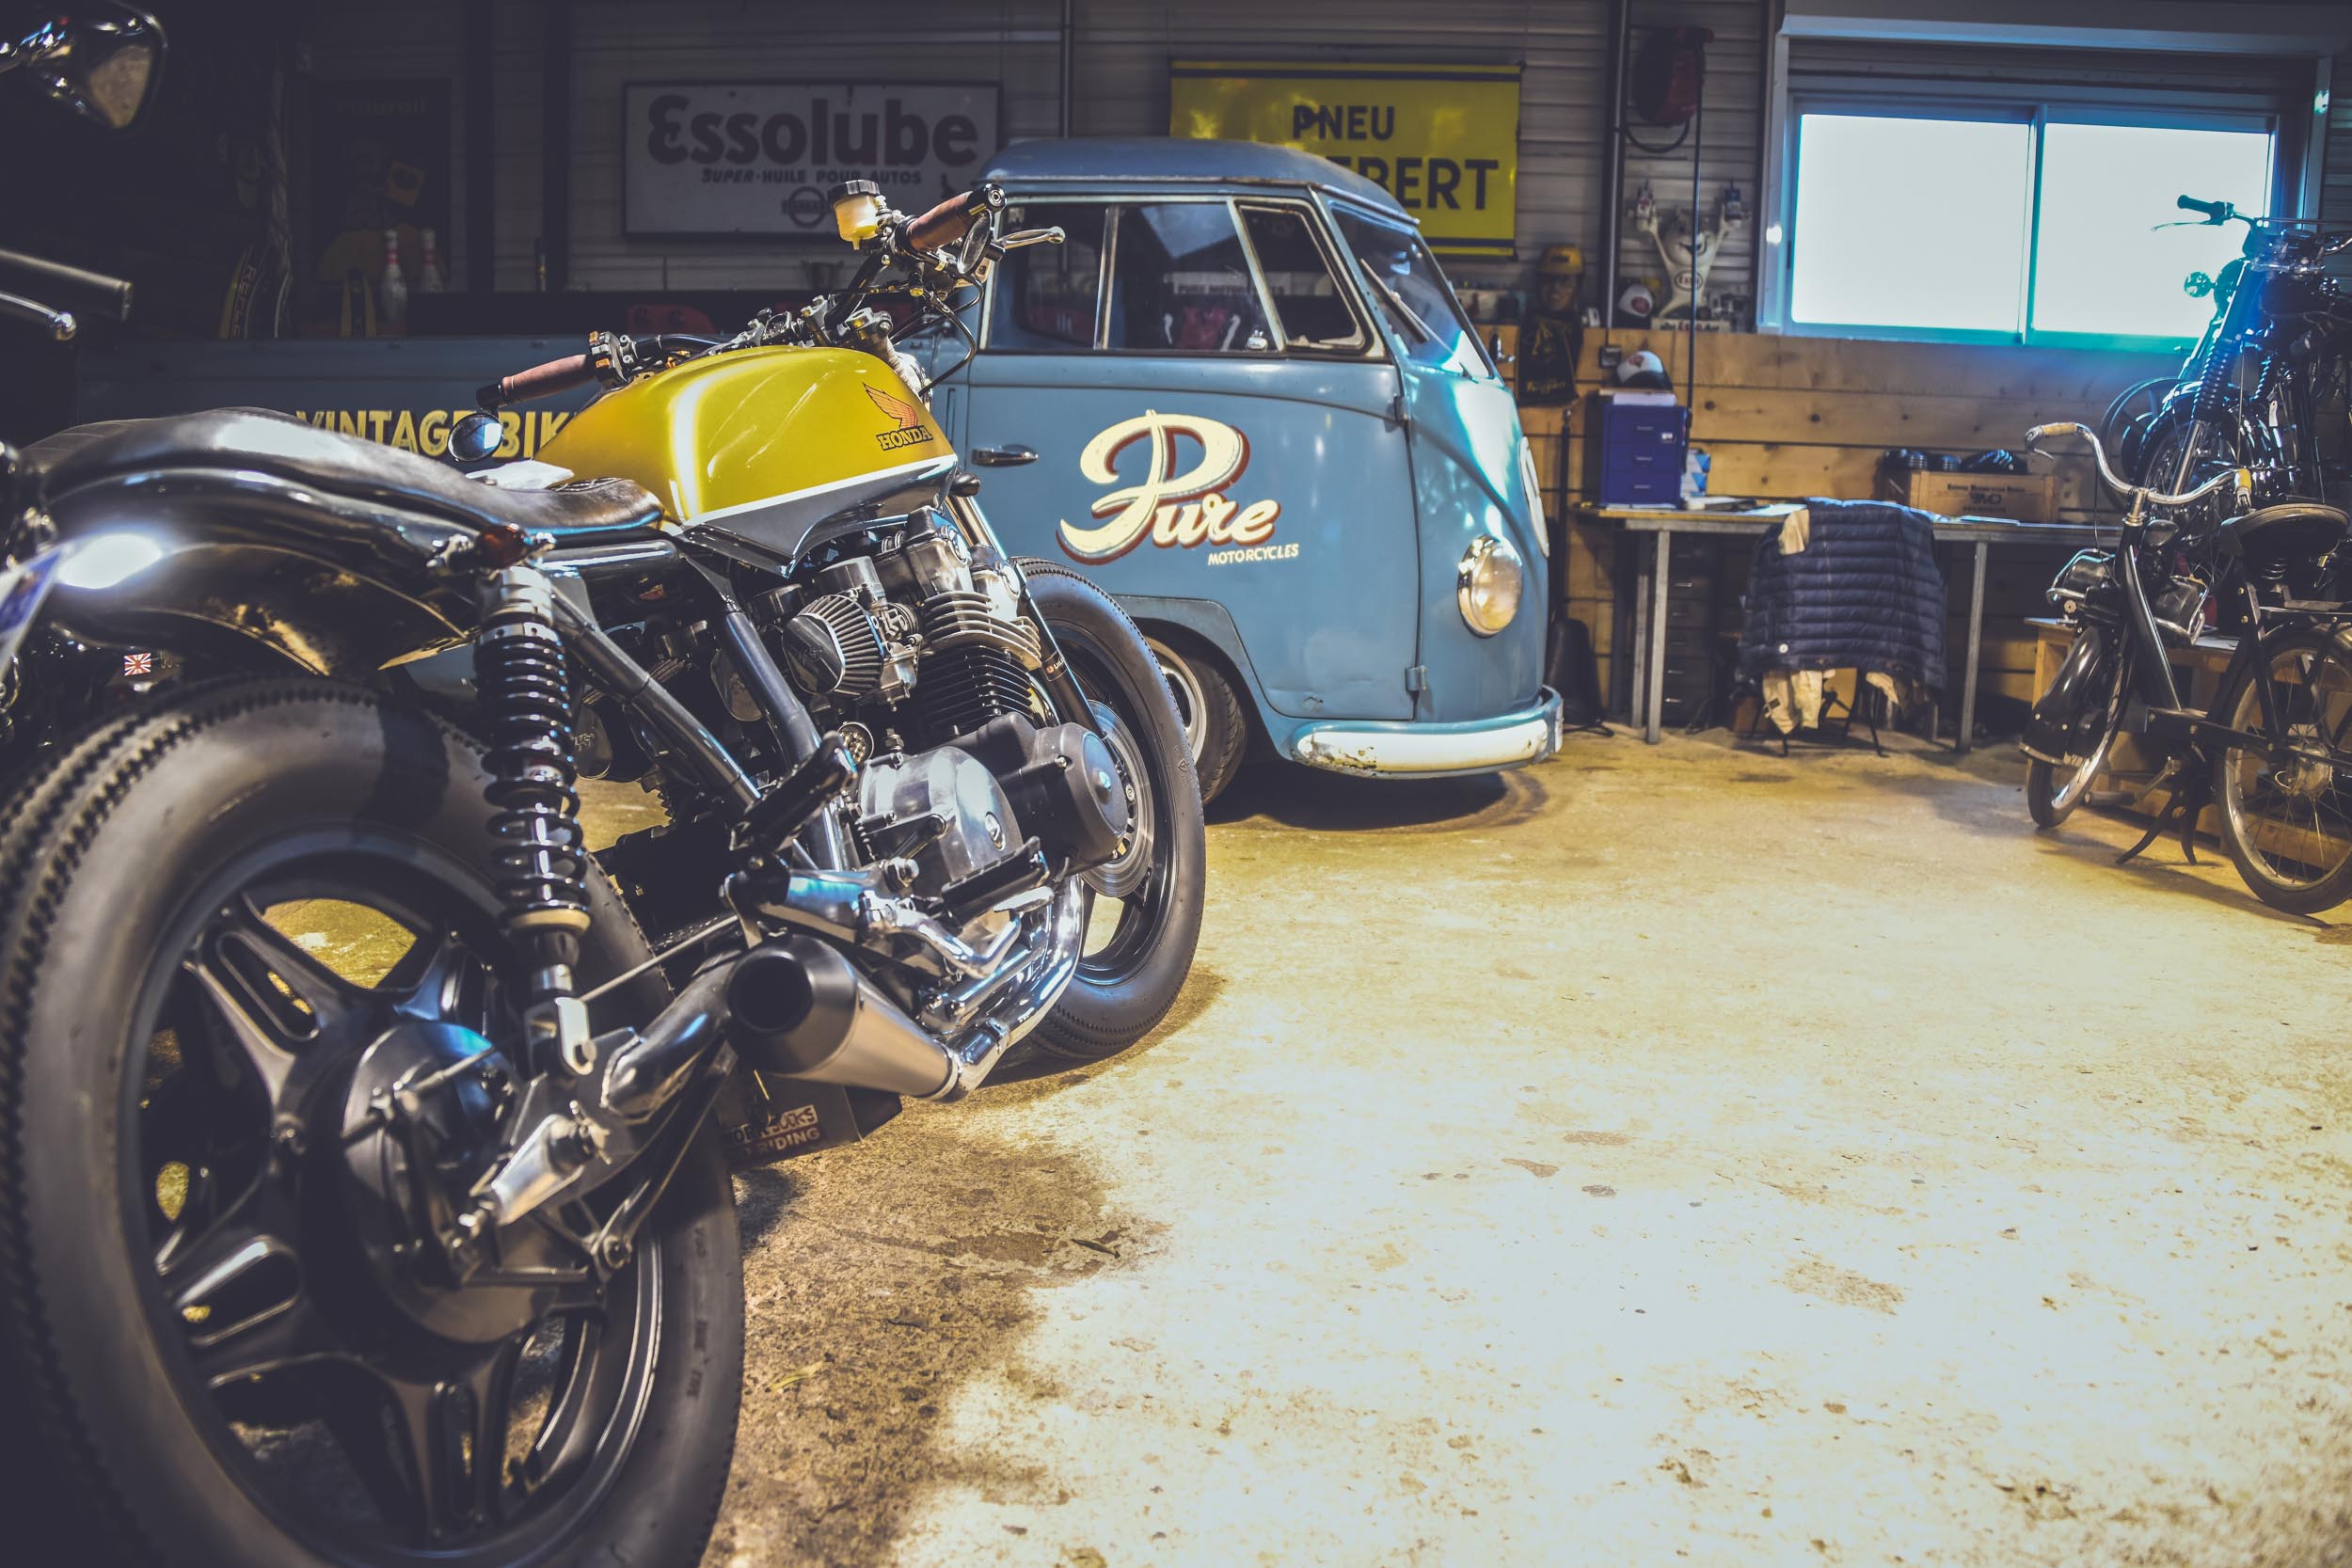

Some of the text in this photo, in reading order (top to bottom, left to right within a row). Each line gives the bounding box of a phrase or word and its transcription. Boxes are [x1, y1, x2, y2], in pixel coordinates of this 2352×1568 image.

[647, 94, 978, 166] Essolube
[1292, 104, 1395, 141] PNEU
[816, 169, 862, 183] POUR
[870, 170, 922, 184] AUTOS
[493, 411, 578, 459] BIK
[876, 425, 933, 451] HONDA
[1056, 409, 1280, 565] Pure
[1208, 543, 1299, 565] MOTORCYCLES
